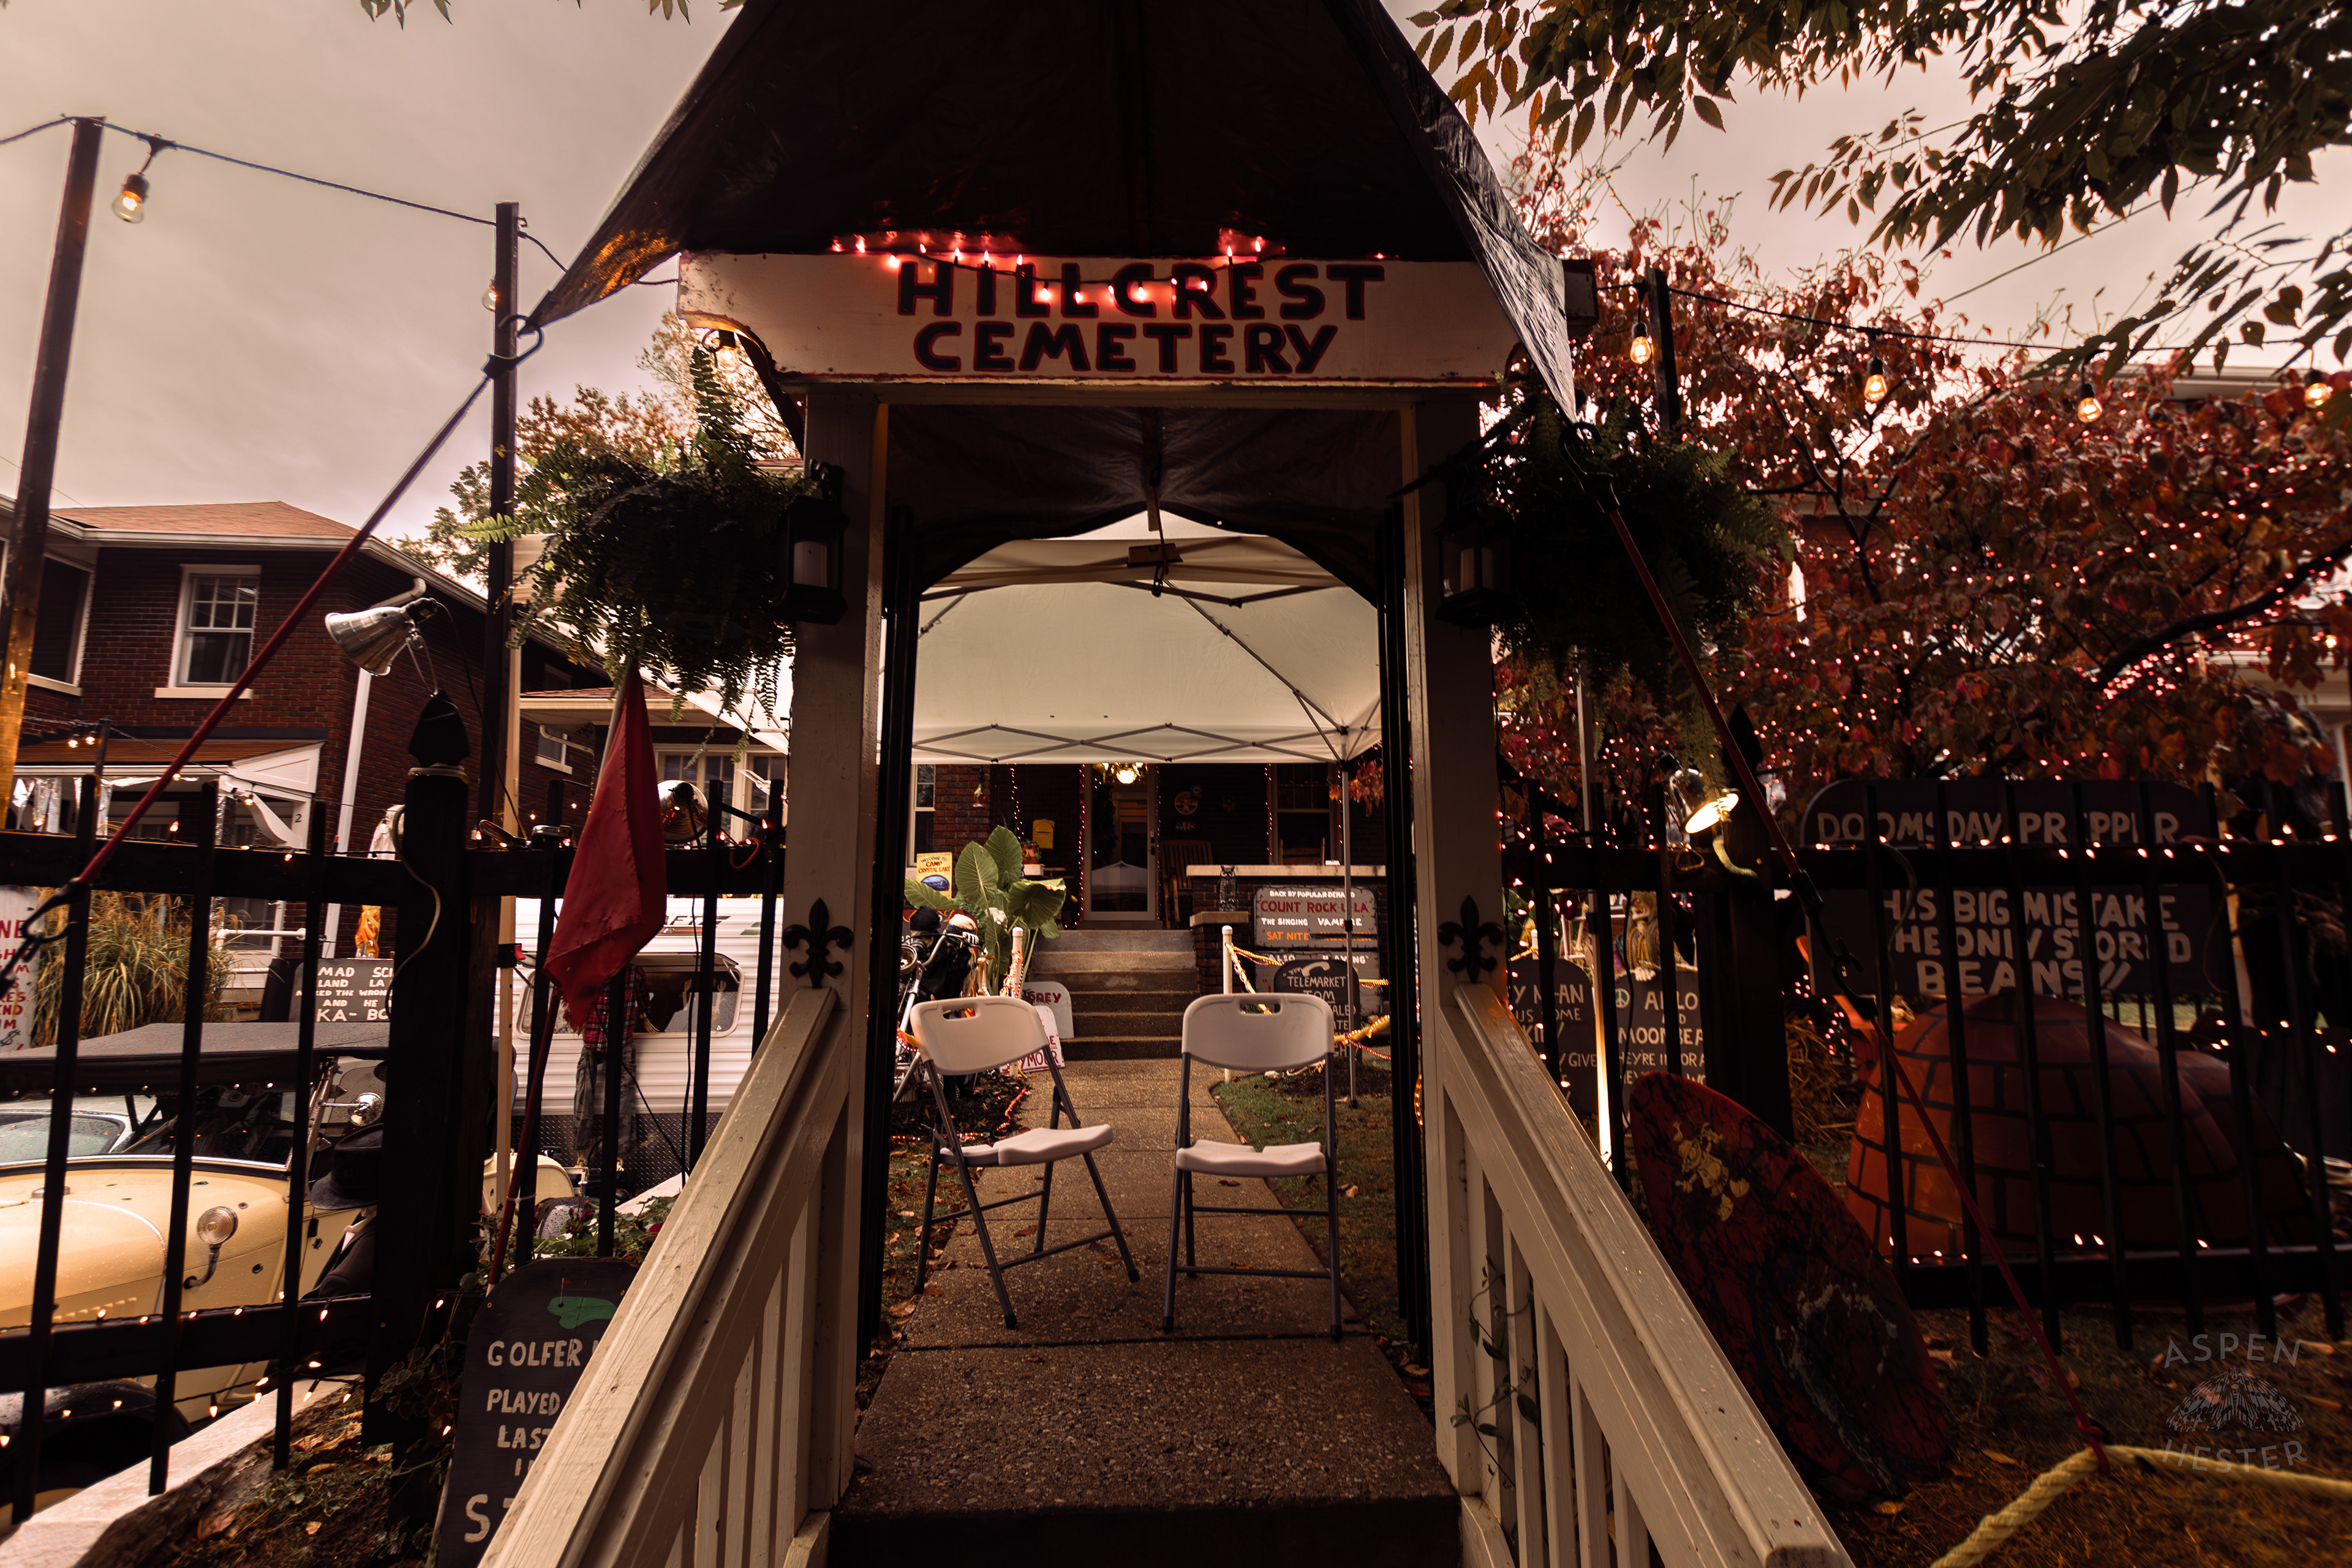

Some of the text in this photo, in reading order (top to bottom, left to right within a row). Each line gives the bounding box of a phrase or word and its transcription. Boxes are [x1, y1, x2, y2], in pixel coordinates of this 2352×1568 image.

[898, 262, 1385, 320] HILLCREST
[913, 321, 1338, 374] CEMETERY
[295, 813, 302, 823] 2
[1953, 889, 2010, 925] BIG
[1277, 918, 1308, 926] SINGING
[1267, 931, 1284, 941] SAT
[1286, 932, 1309, 941] NITE
[317, 967, 355, 977] MAD
[487, 1338, 582, 1367] GOLFER
[486, 1389, 561, 1416] PLAYED
